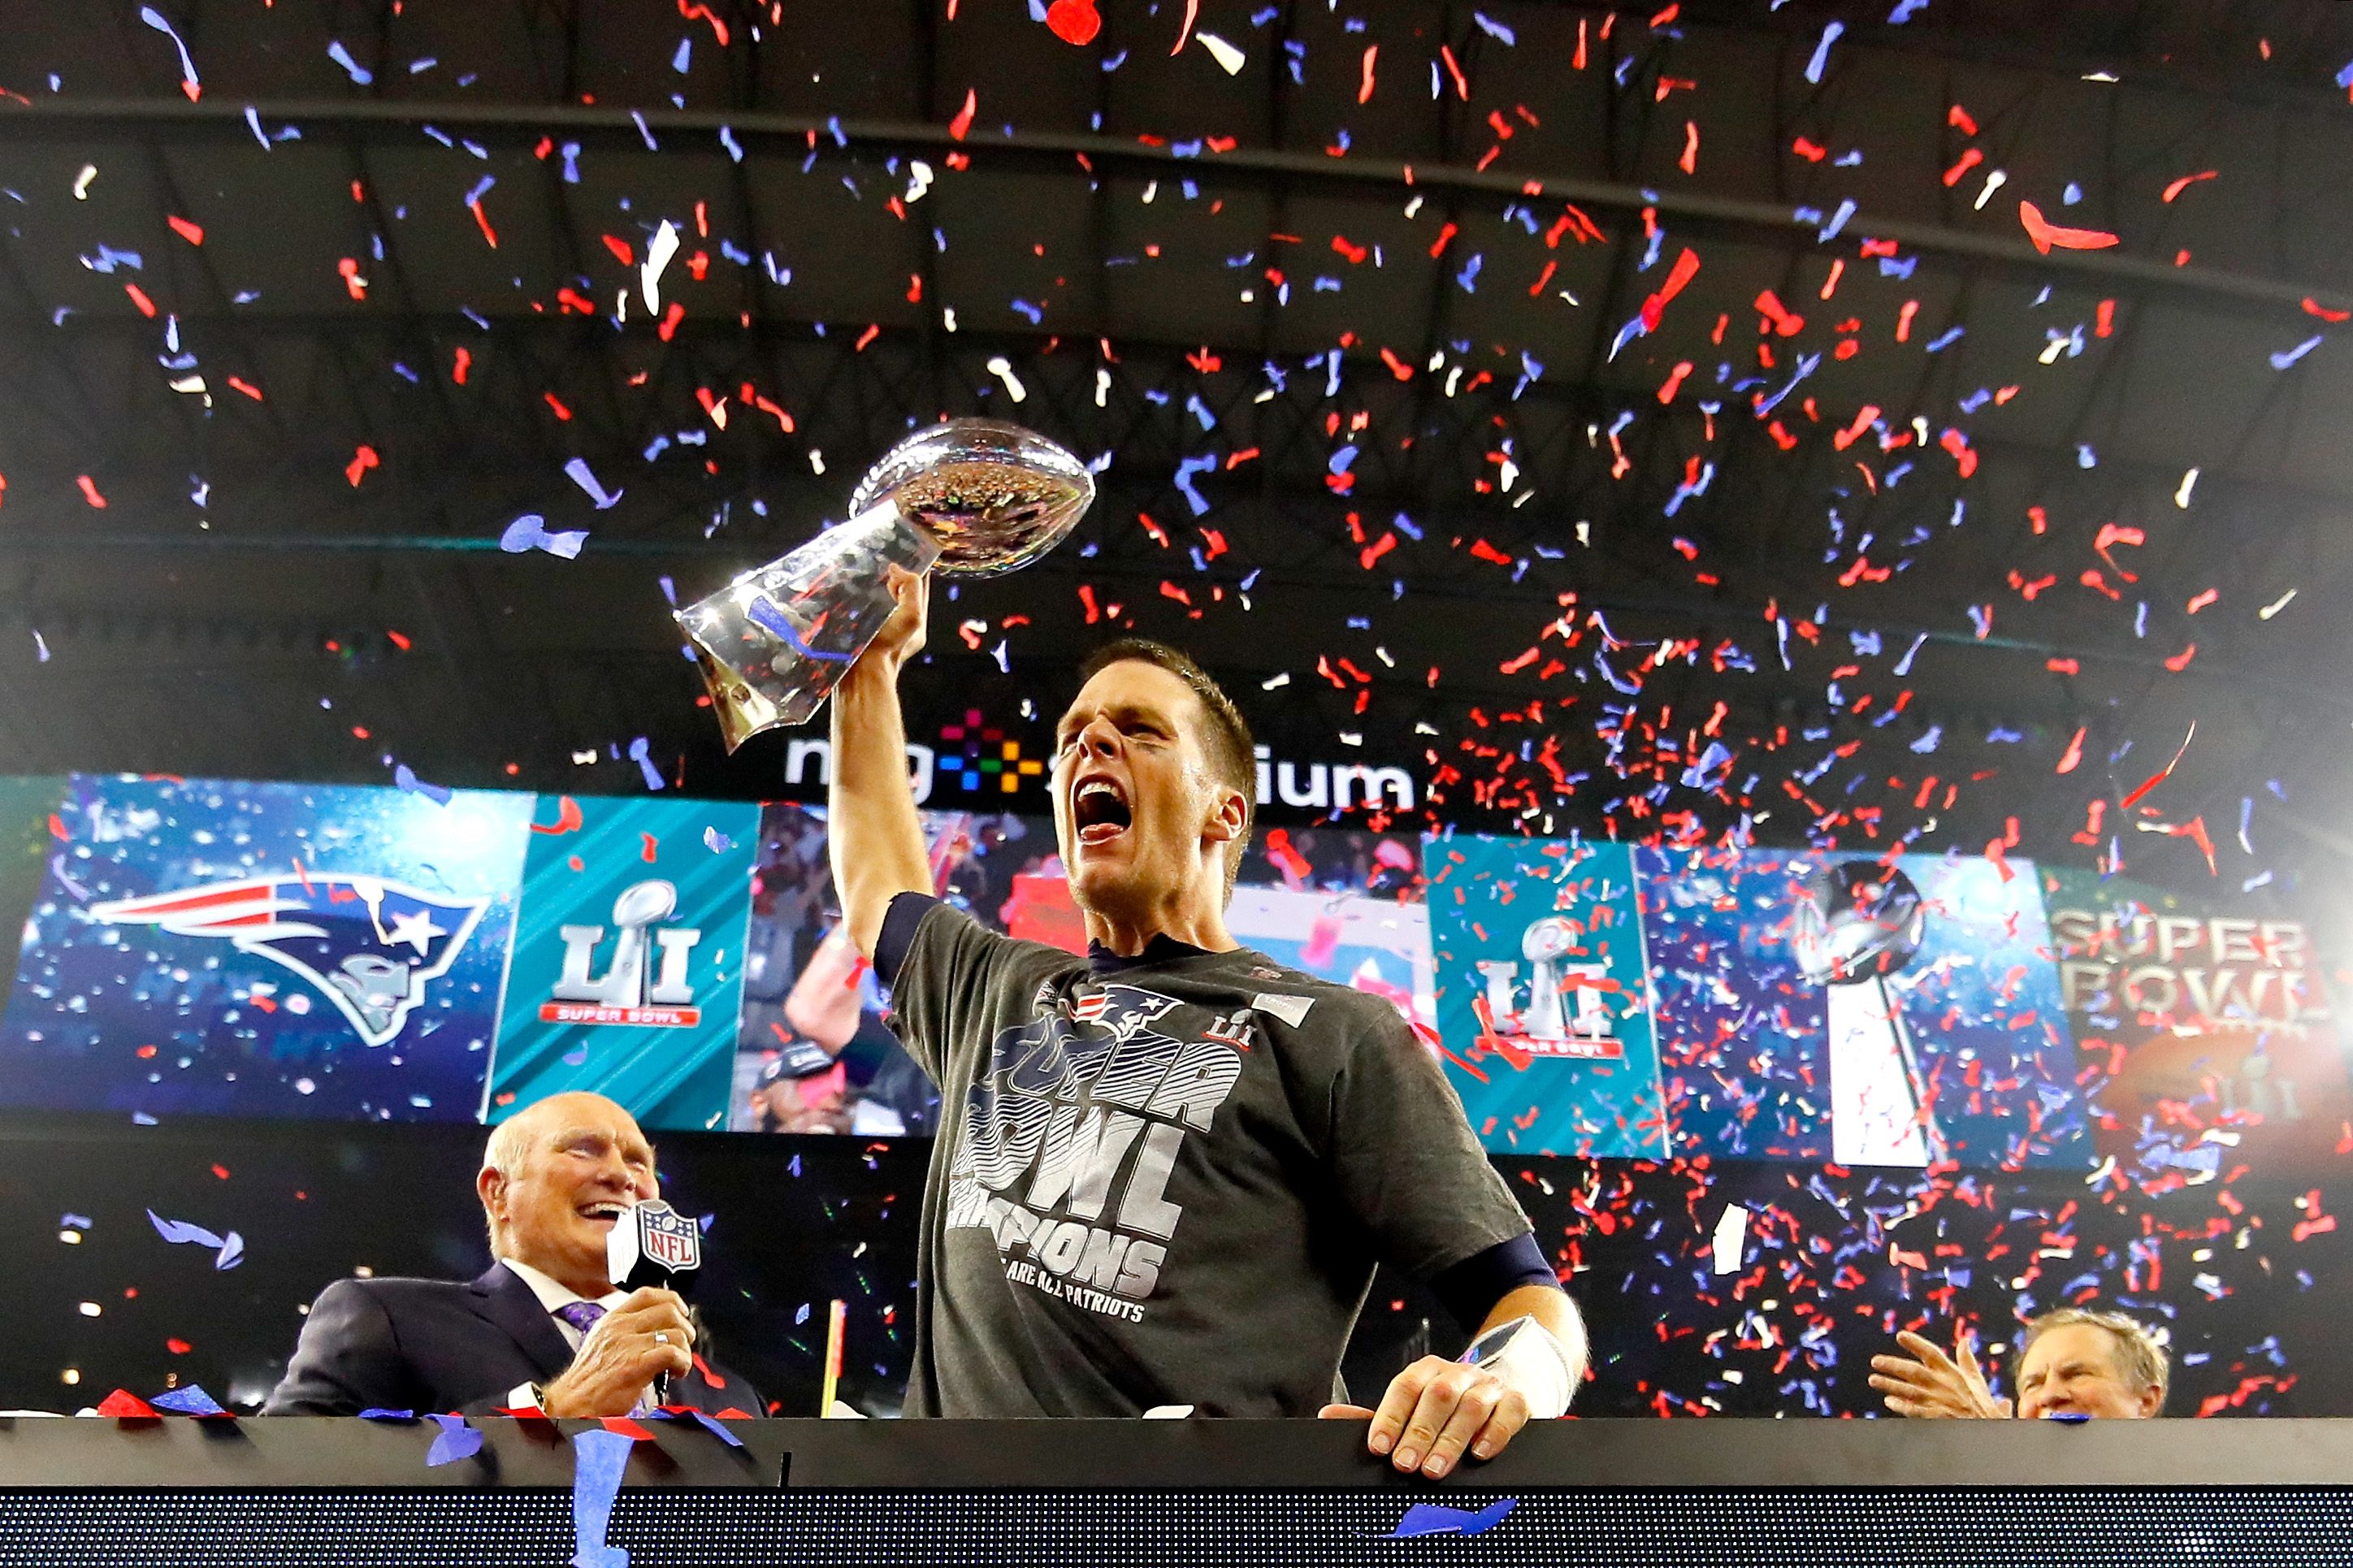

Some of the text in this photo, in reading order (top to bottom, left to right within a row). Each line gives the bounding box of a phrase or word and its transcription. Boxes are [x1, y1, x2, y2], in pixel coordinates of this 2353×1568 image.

[785, 739, 934, 805] ng
[552, 925, 701, 1003] LI
[2050, 909, 2307, 967] SUPER
[557, 1008, 681, 1024] SUPER BOWL
[2062, 961, 2330, 1022] BOWL
[649, 1232, 691, 1262] NFL
[1006, 1260, 1146, 1323] ARE ALL PATRIOTS
